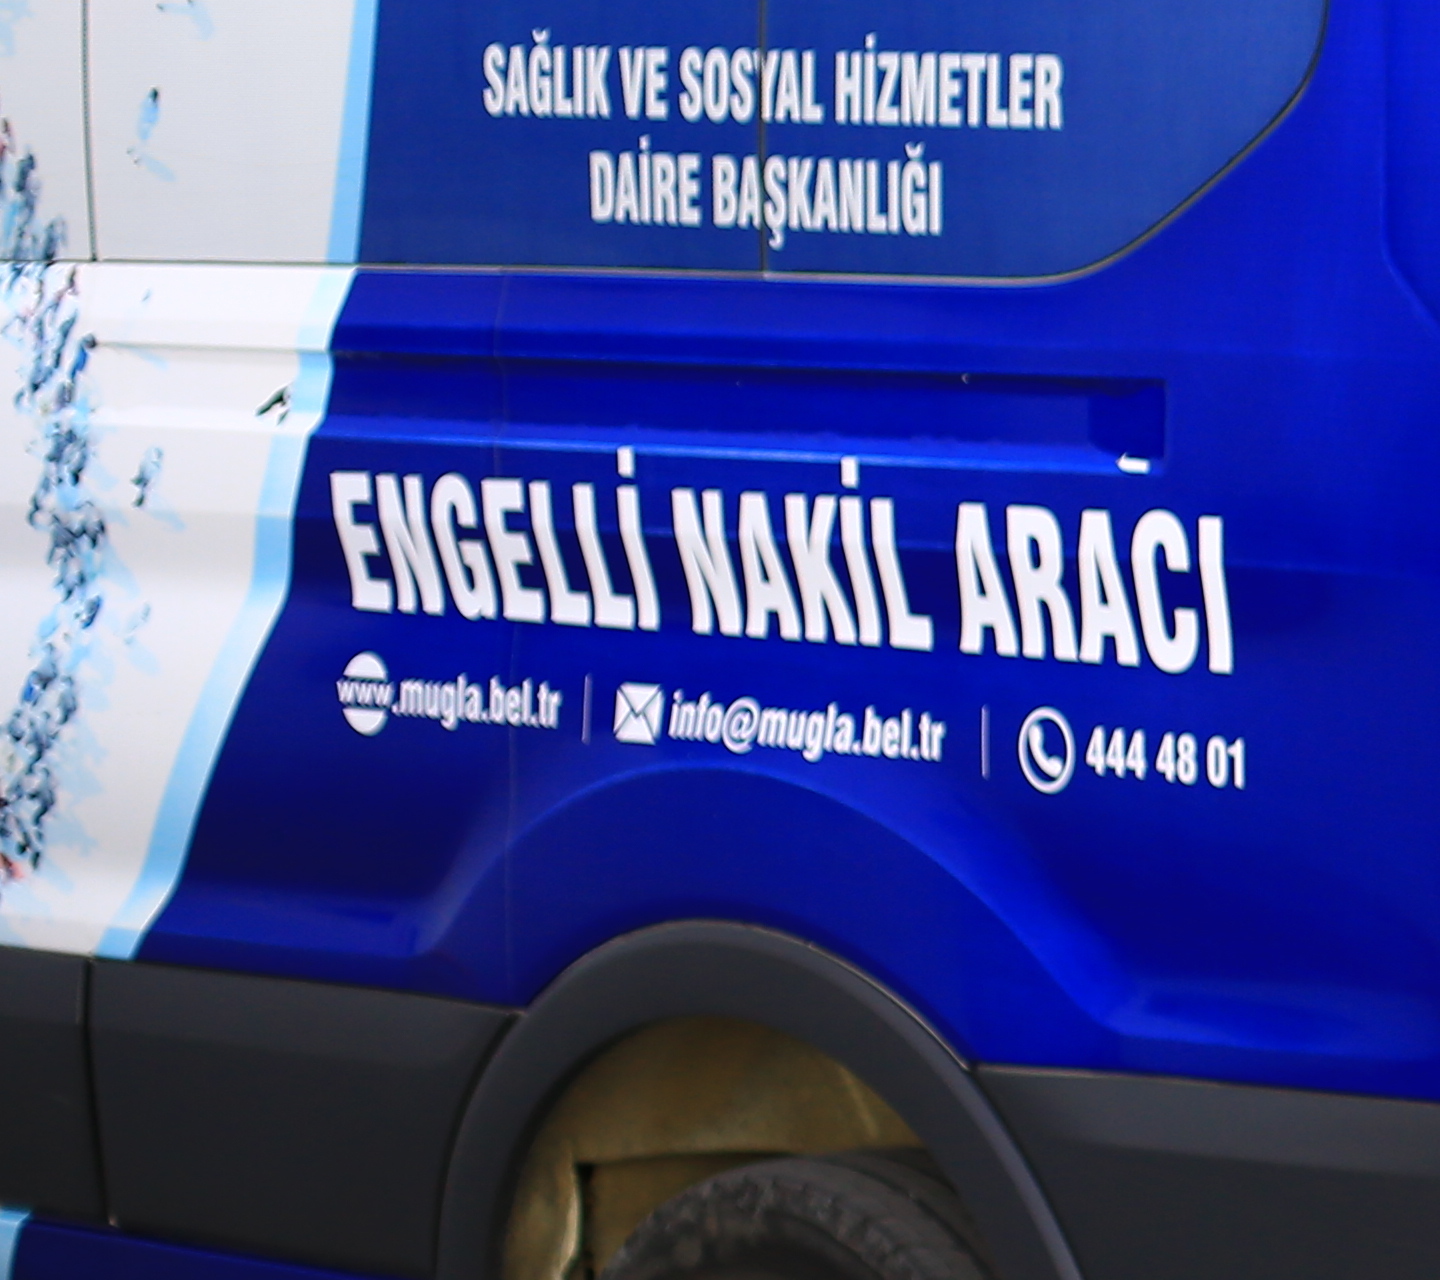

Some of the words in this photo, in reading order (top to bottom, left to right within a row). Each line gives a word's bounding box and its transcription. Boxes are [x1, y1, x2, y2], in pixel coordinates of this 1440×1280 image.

[482, 27, 612, 119] SAĞLIK
[617, 45, 670, 120] VE
[678, 45, 825, 125] SOSYAL
[834, 31, 1064, 131] HİZMETLER
[588, 133, 702, 227] DAİRE
[711, 141, 943, 251] BAŞKANLIĞI
[329, 445, 660, 632] ENGELLİ
[670, 456, 934, 652] NAKİL
[955, 501, 1234, 675] ARACI
[335, 672, 563, 732] www.mugla.bel.tr
[668, 688, 946, 763] info@mugla.bel.tr
[1085, 725, 1147, 780] 444
[1155, 730, 1198, 786] 48
[1206, 735, 1245, 790] 01
